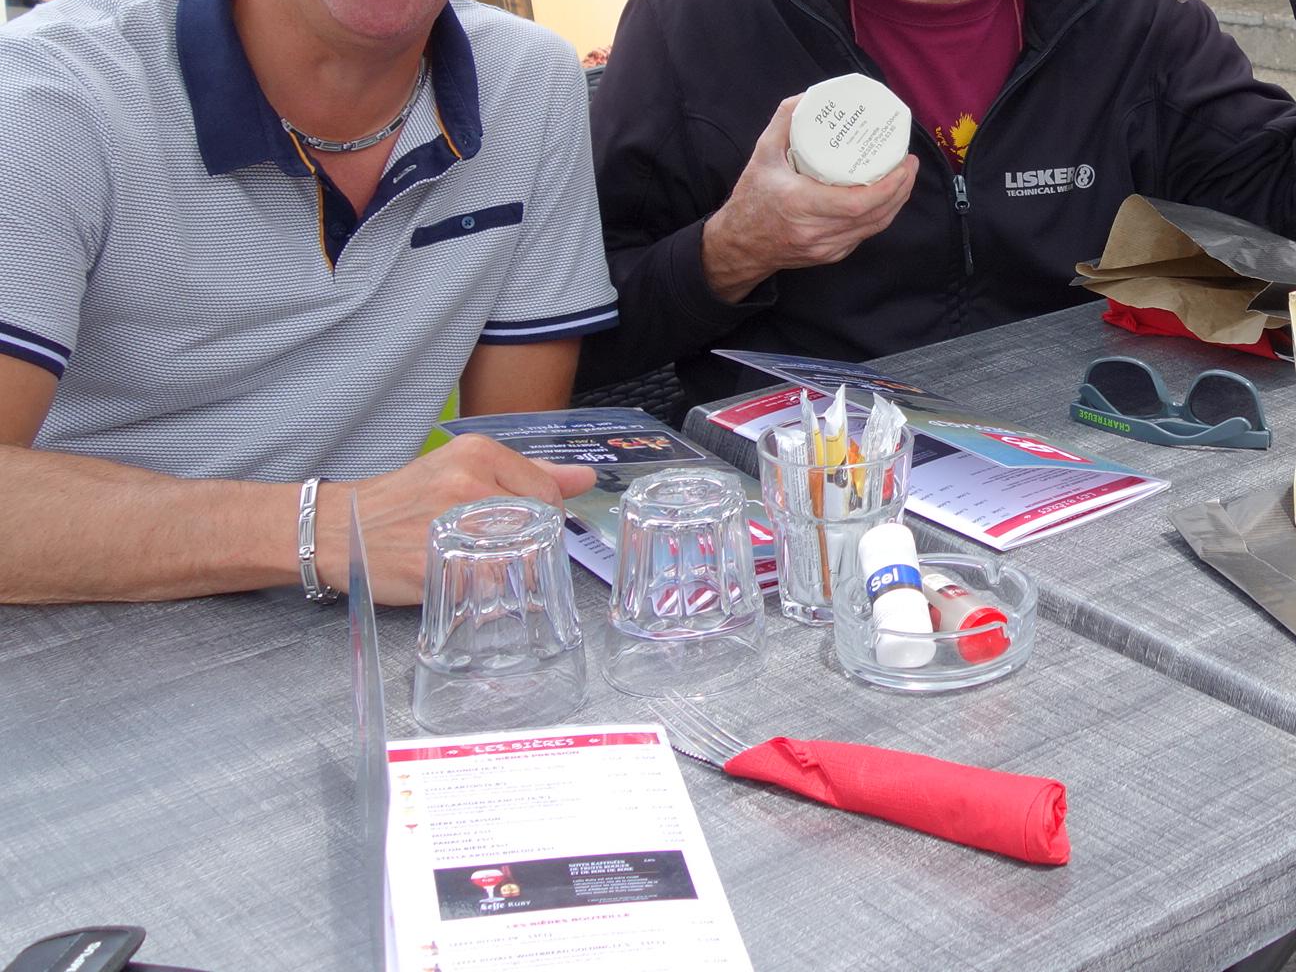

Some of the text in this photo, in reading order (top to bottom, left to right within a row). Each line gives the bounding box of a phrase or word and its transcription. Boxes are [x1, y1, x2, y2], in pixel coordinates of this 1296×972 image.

[815, 99, 837, 126] Pâté
[828, 110, 846, 130] à la
[829, 104, 866, 149] Gentiane
[1005, 167, 1075, 188] LISKER
[1006, 186, 1056, 197] TECHNICAL
[1079, 409, 1131, 432] CHARTREUSE
[871, 568, 899, 592] Sel
[474, 738, 575, 753] LES BIÈRES
[507, 899, 532, 908] RUBY
